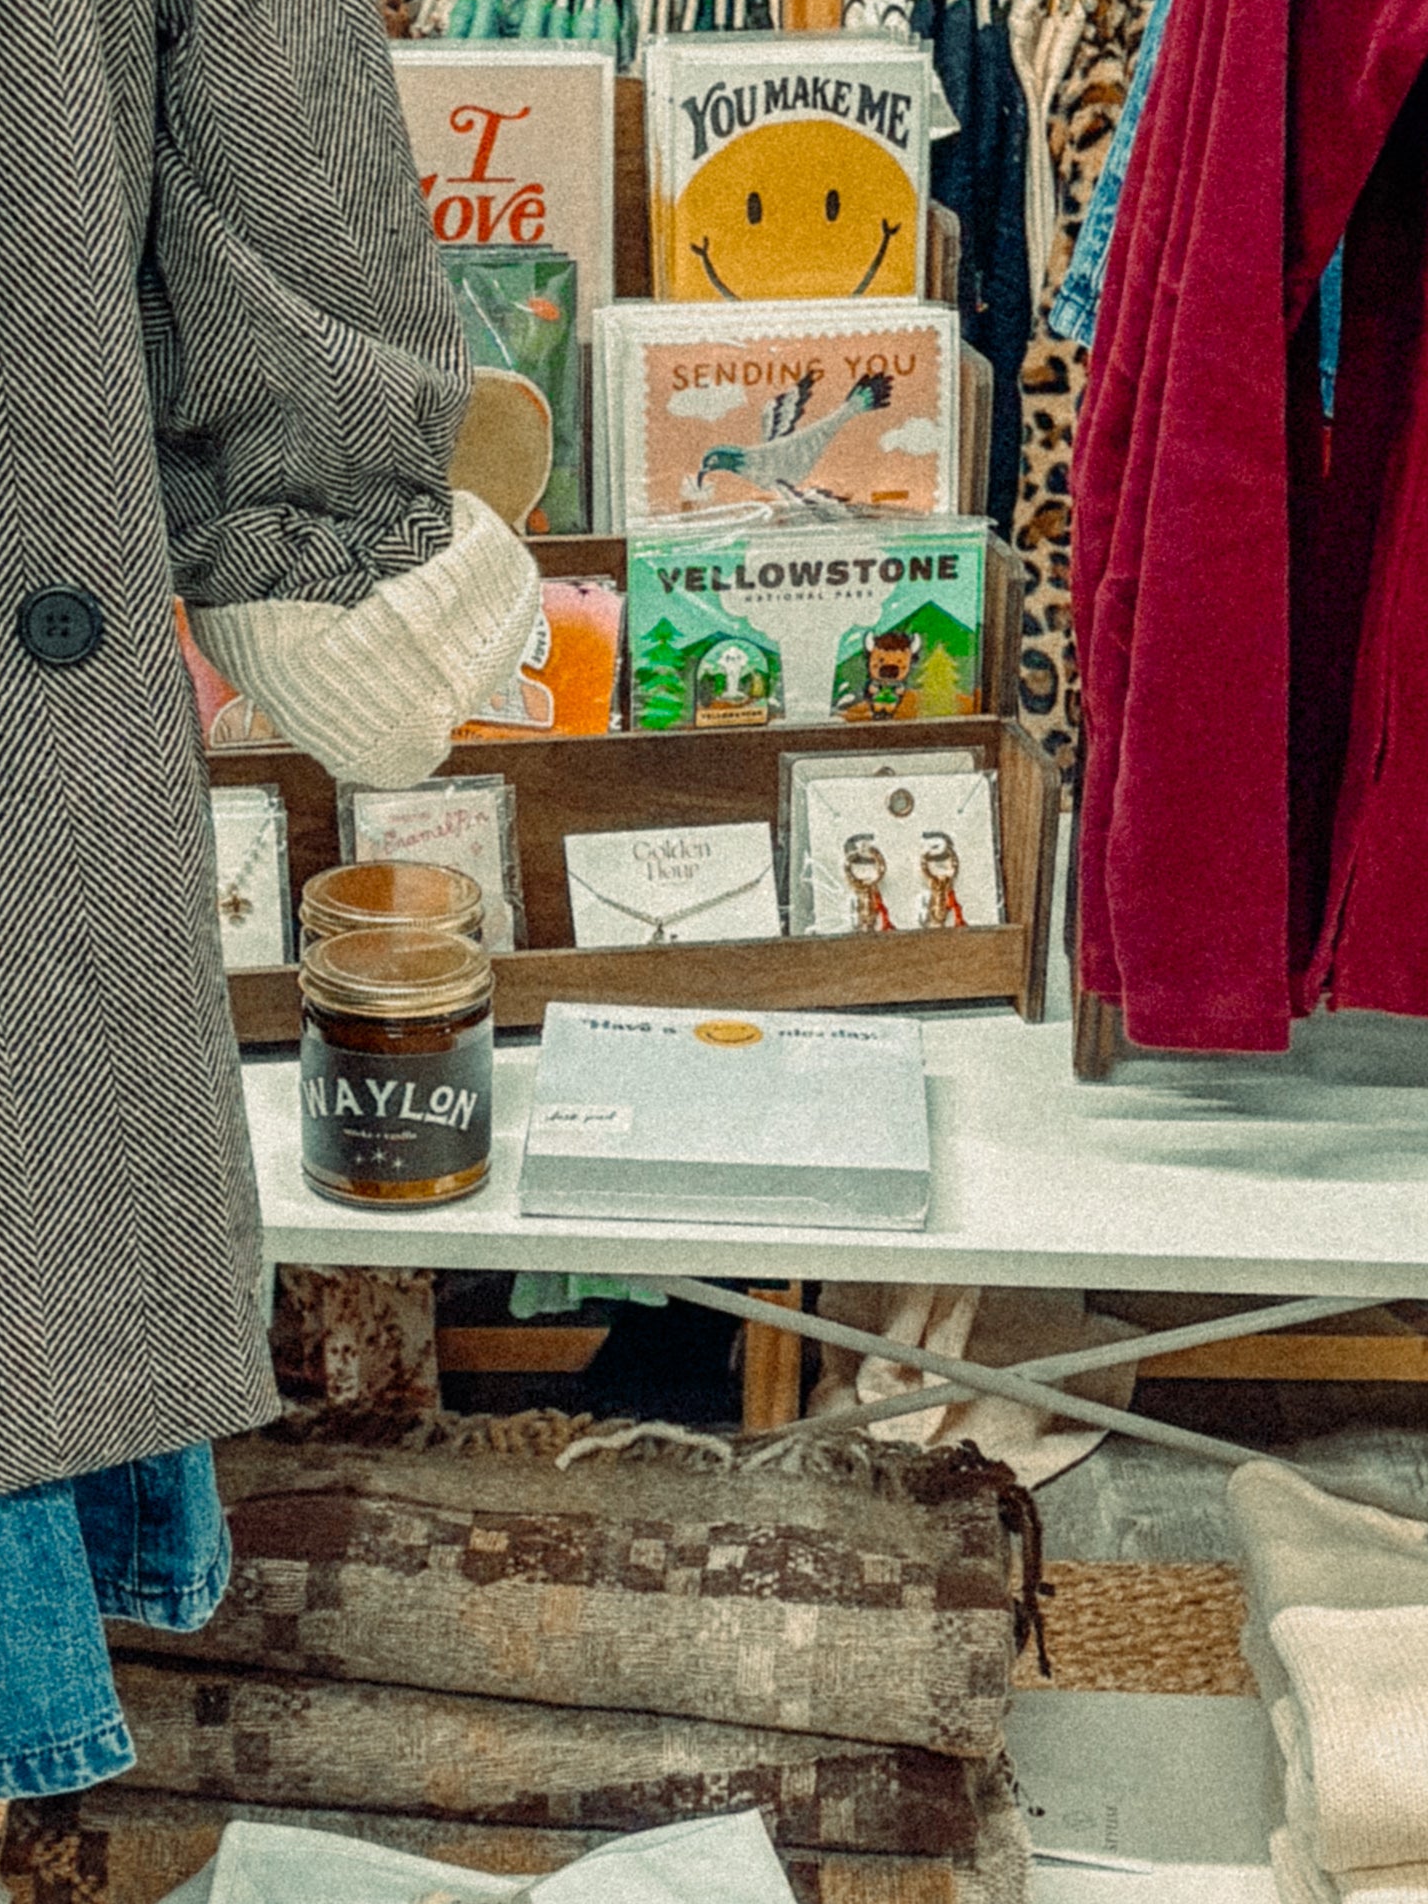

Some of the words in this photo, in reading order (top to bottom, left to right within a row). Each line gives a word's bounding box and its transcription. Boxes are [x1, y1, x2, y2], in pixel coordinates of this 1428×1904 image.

[680, 80, 758, 160] YOU
[763, 75, 852, 118] MAKE
[855, 82, 911, 150] ME
[448, 105, 532, 183] I
[672, 358, 825, 391] SENDING
[844, 353, 917, 380] YOU
[656, 553, 960, 594] YELLOWSTONE
[632, 839, 711, 861] Golden
[302, 1076, 478, 1131] WAYLON
